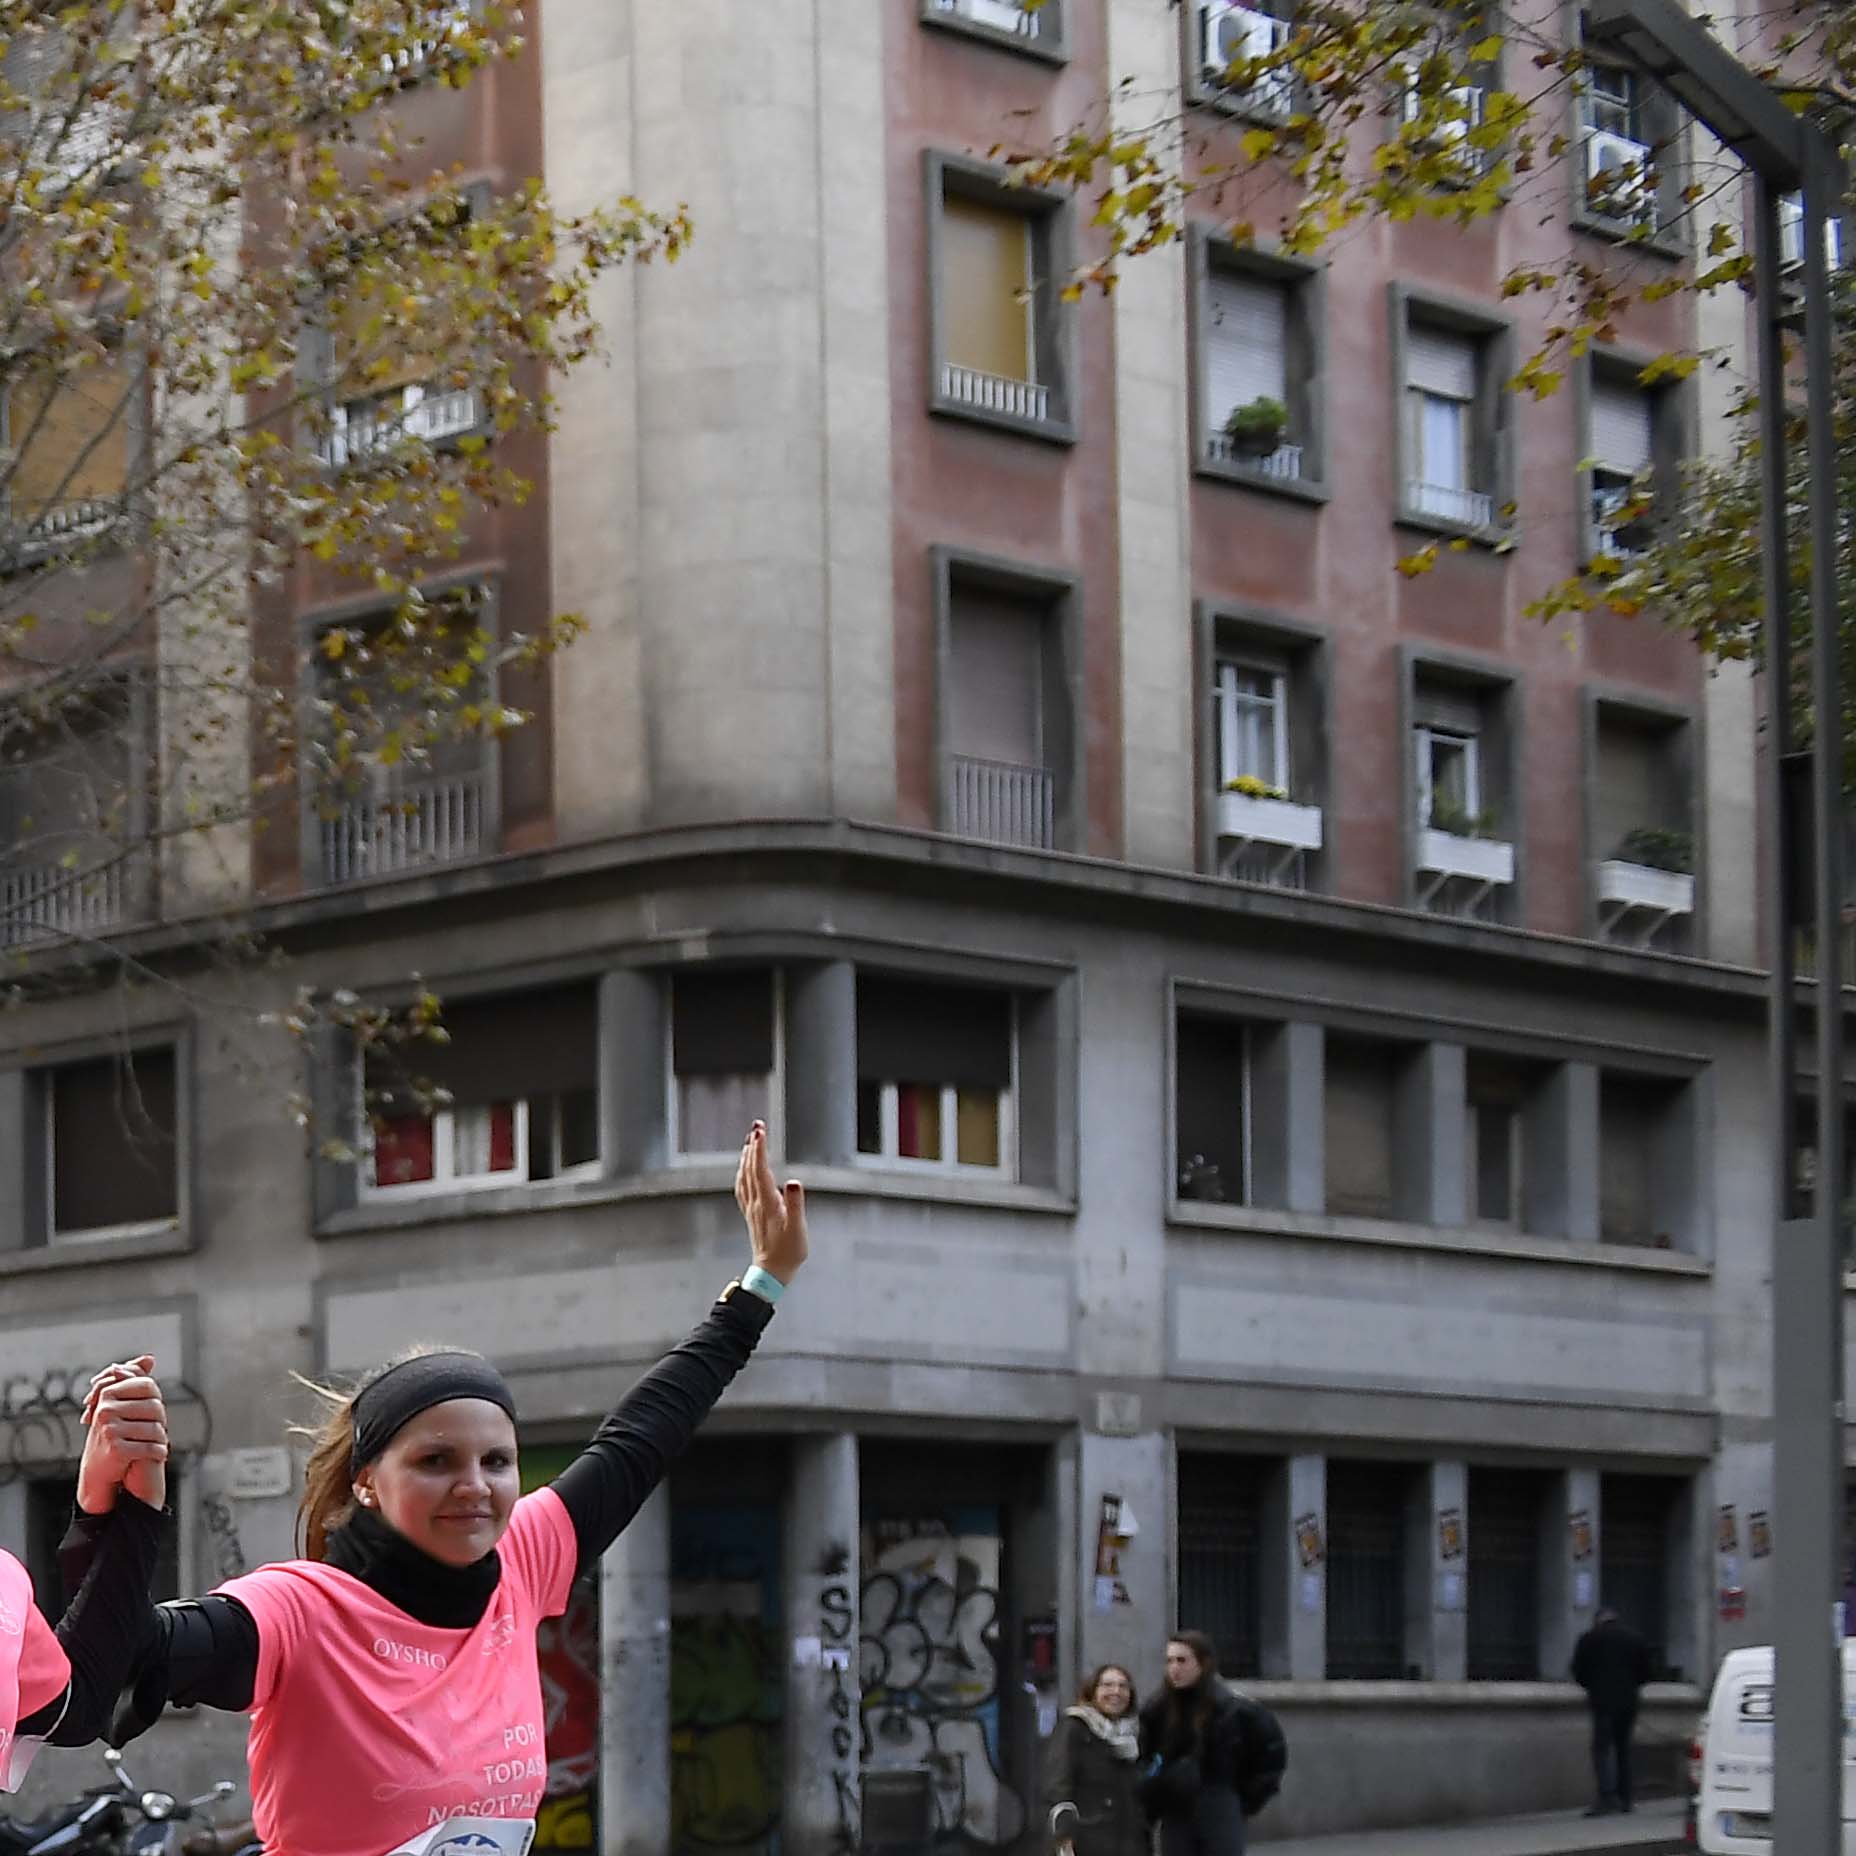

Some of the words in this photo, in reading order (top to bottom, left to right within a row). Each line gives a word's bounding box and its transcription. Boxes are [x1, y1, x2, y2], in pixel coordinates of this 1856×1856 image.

[373, 1637, 448, 1672] OYSHO
[503, 1723, 537, 1750] POR
[483, 1754, 544, 1785] TODAS
